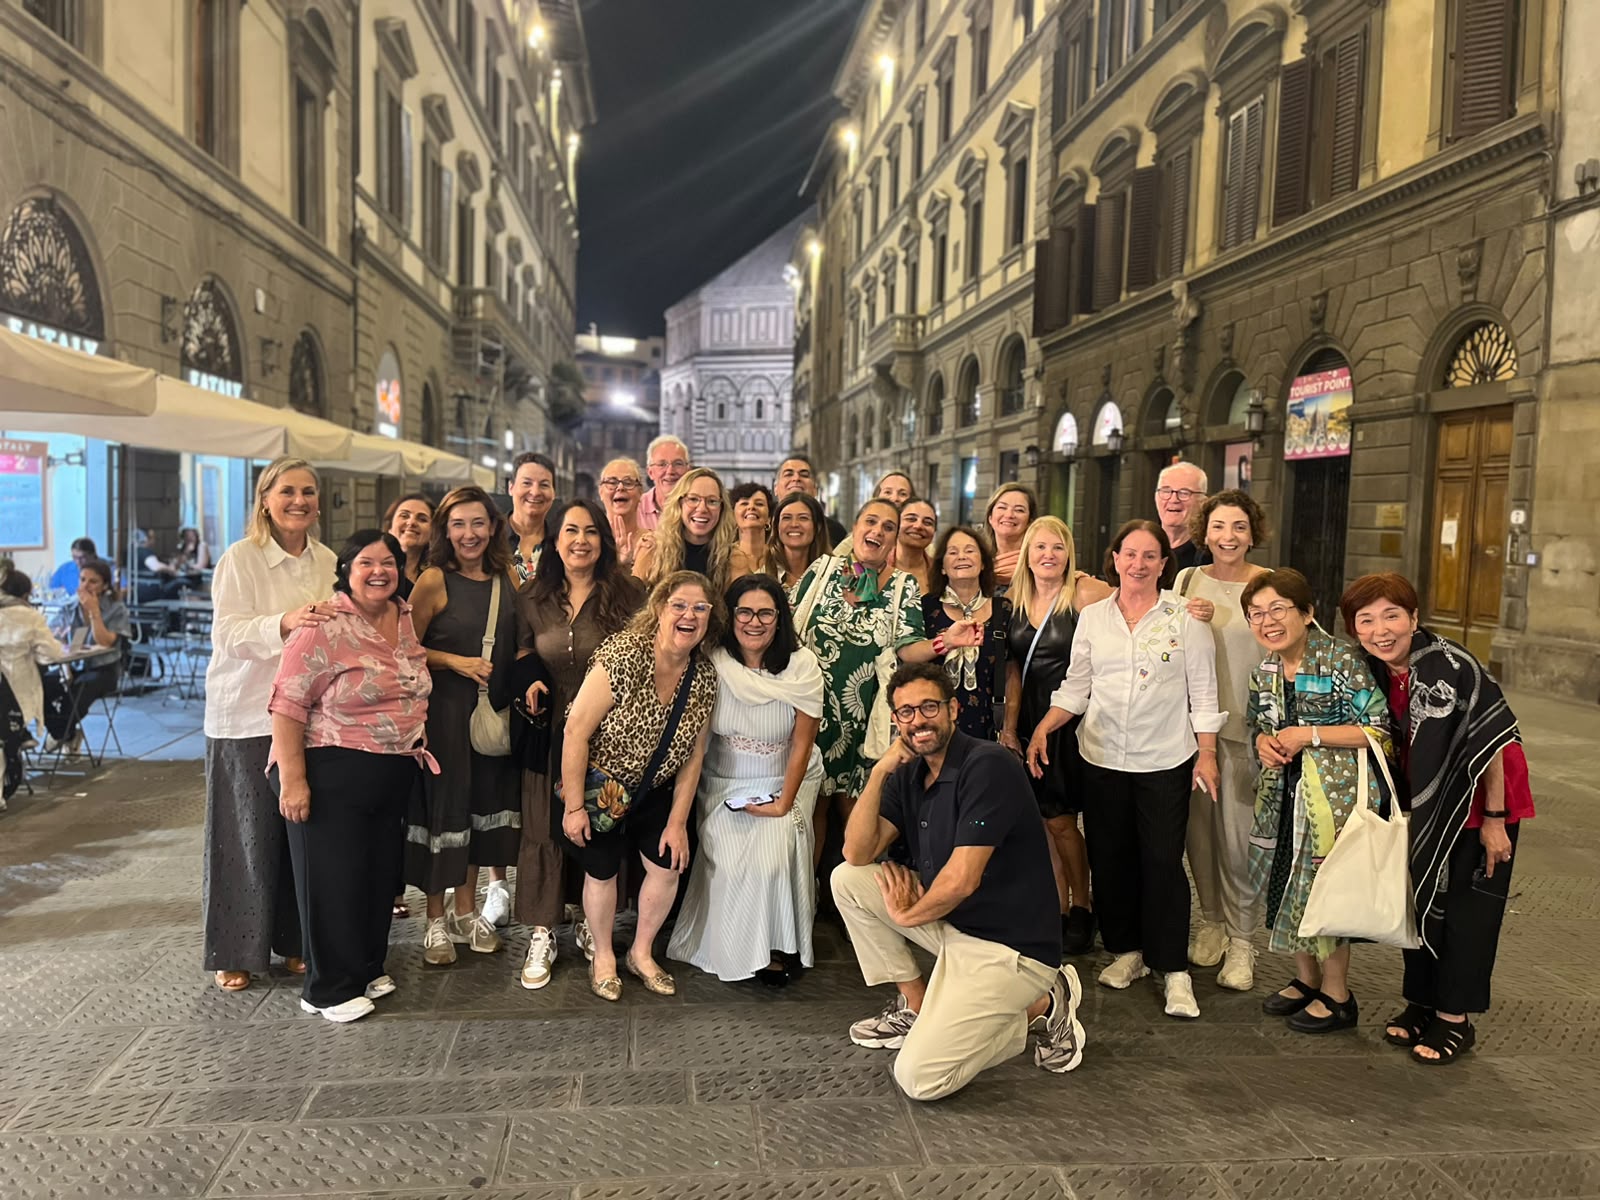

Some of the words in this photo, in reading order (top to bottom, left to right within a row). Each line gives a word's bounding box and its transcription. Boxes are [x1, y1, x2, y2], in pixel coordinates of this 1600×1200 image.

[8, 316, 98, 356] EATALY
[190, 369, 242, 399] EATALY
[1290, 382, 1323, 398] TOURIST
[1323, 375, 1351, 392] POINT
